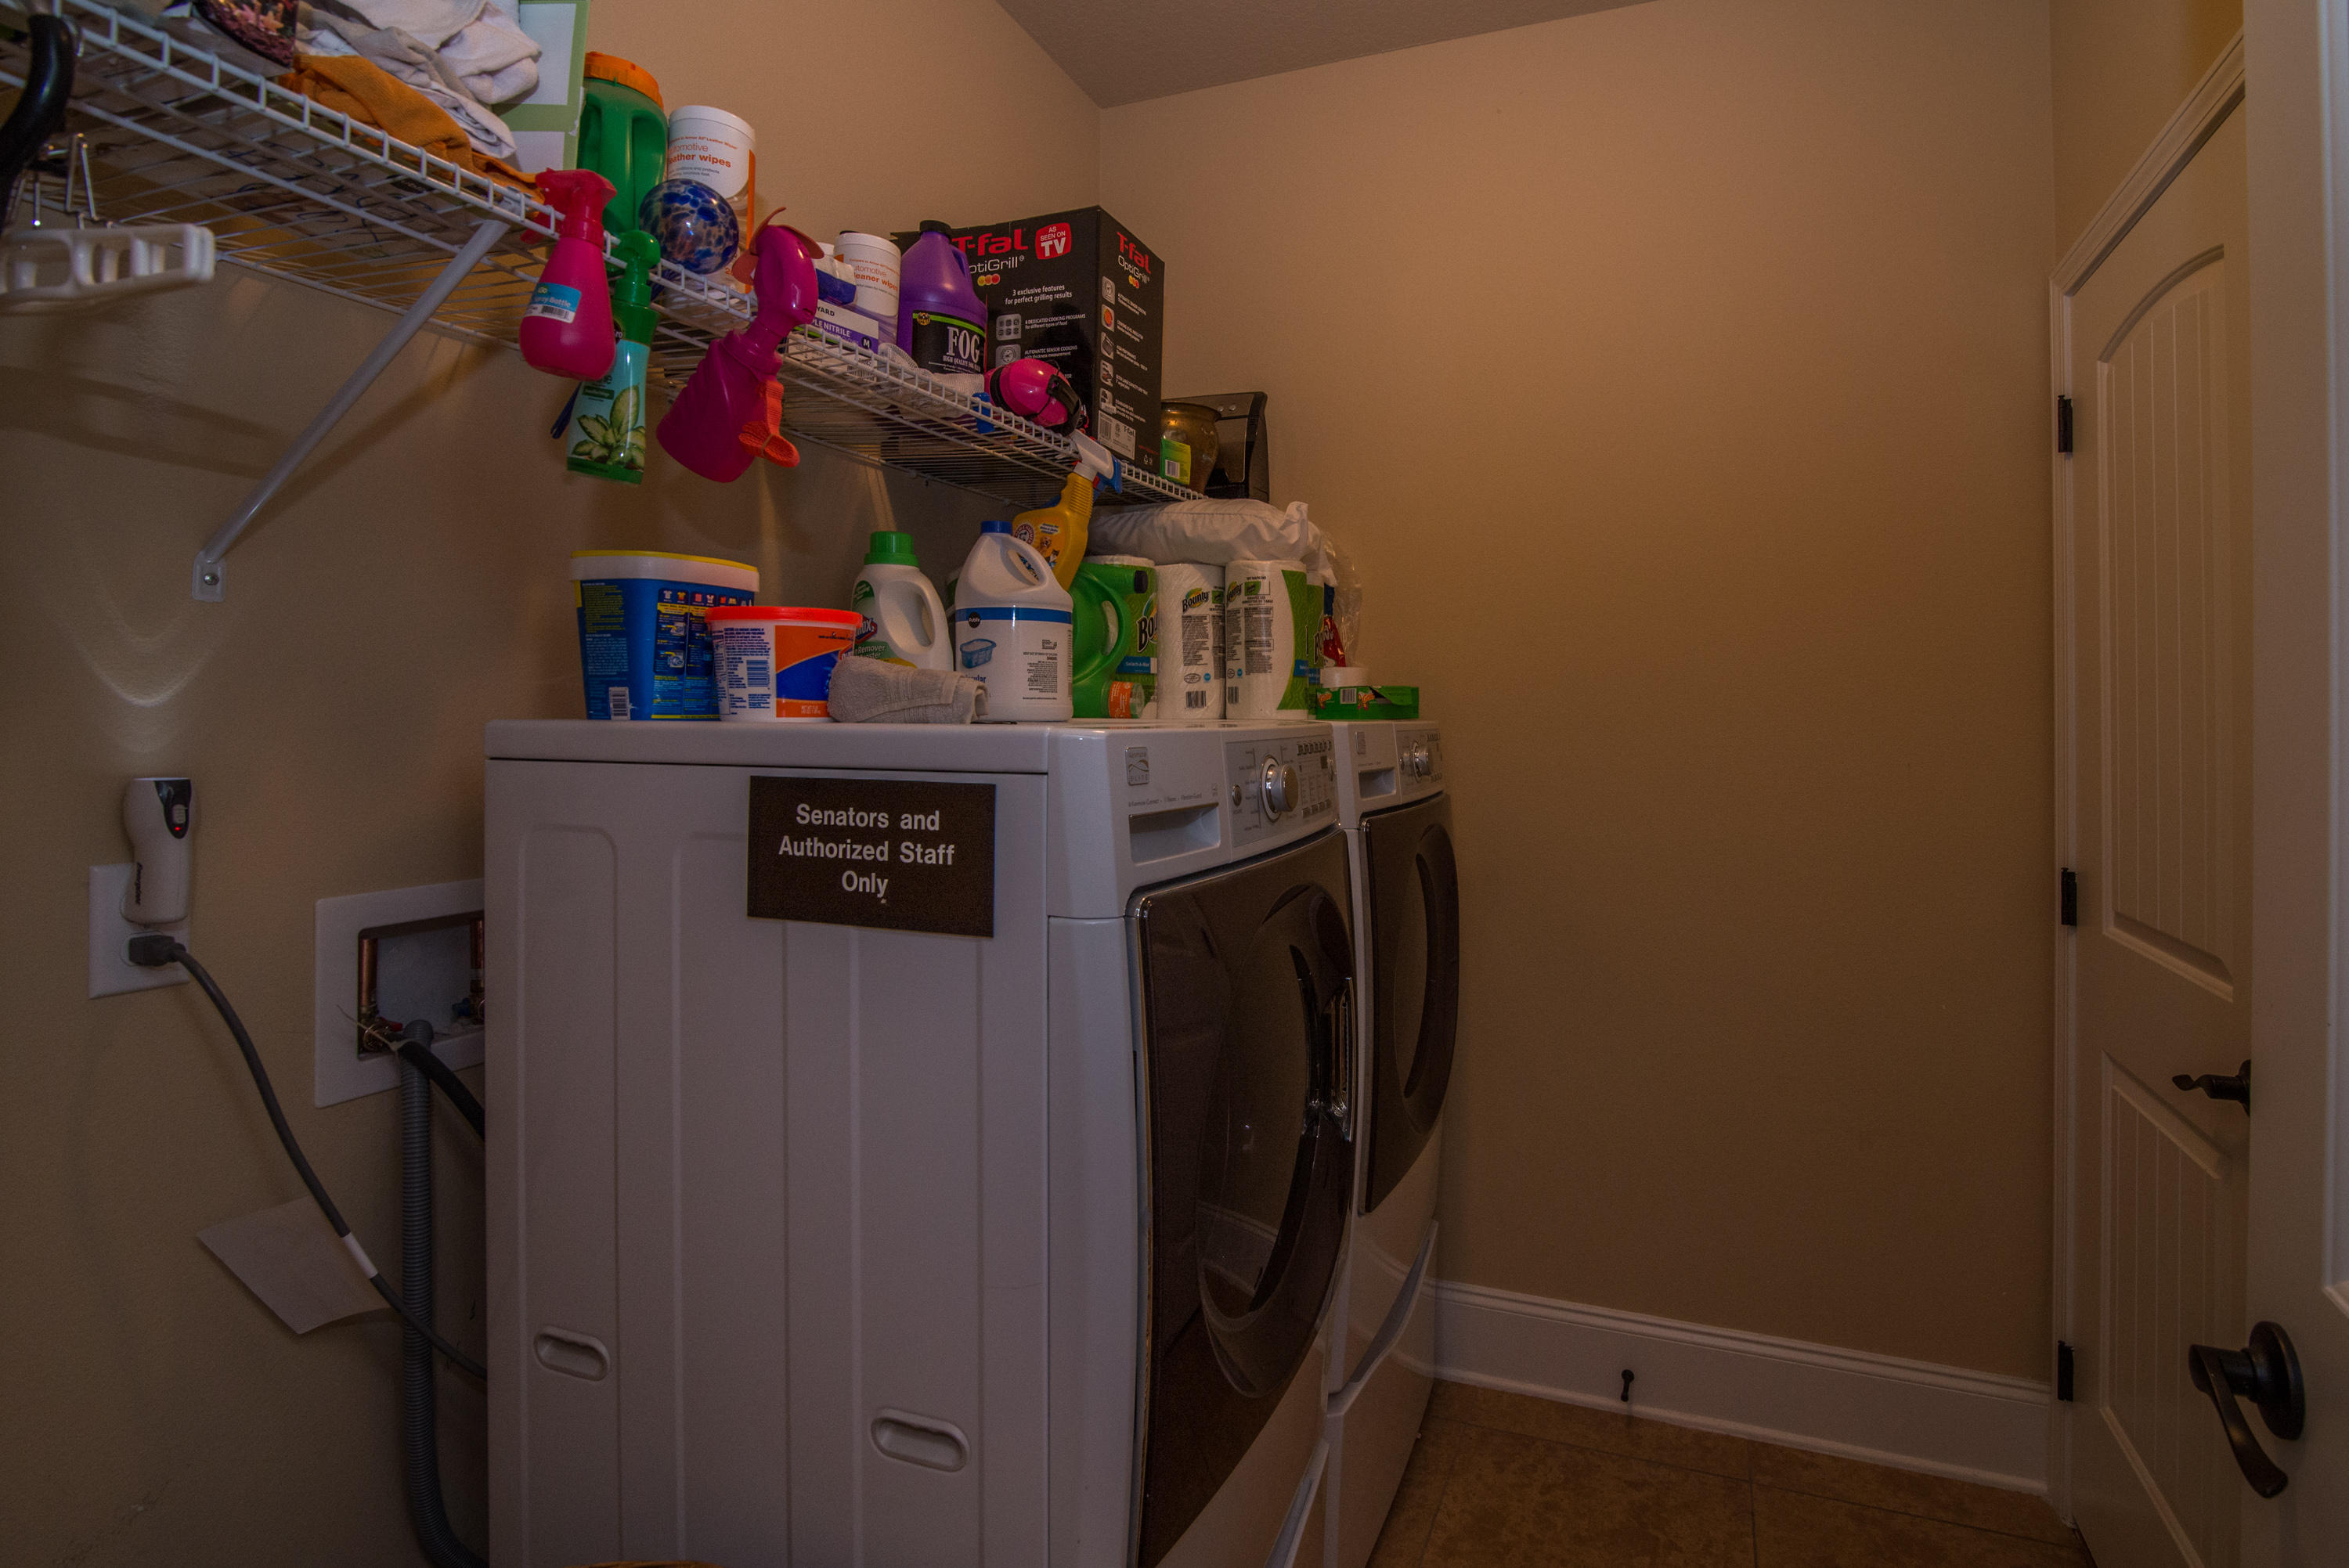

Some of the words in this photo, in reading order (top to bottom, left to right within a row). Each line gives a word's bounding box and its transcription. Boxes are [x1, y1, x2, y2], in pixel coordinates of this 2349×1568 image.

[669, 153, 696, 165] eather
[698, 154, 731, 168] wipes
[951, 229, 1029, 257] T-fal
[1040, 233, 1056, 242] SEEN
[1041, 236, 1066, 258] TV
[1117, 231, 1152, 275] T-fal
[853, 272, 880, 283] leaner
[1014, 295, 1034, 305] perfect
[1034, 292, 1053, 302] grilling
[1054, 290, 1073, 299] results
[1017, 287, 1041, 296] exclusive
[1042, 284, 1065, 293] features
[549, 296, 572, 308] Bottle
[817, 306, 835, 316] YARD
[823, 322, 852, 338] NITRILE
[864, 339, 871, 350] M
[946, 326, 980, 364] FOG
[1227, 583, 1243, 603] ounty
[1182, 590, 1209, 613] Bounty
[857, 644, 886, 653] Remover
[1130, 773, 1149, 782] ELITE
[796, 803, 889, 828] Senators
[900, 809, 940, 831] and
[778, 835, 889, 862] Authorized
[899, 841, 955, 865] Staff
[841, 870, 889, 898] Only
